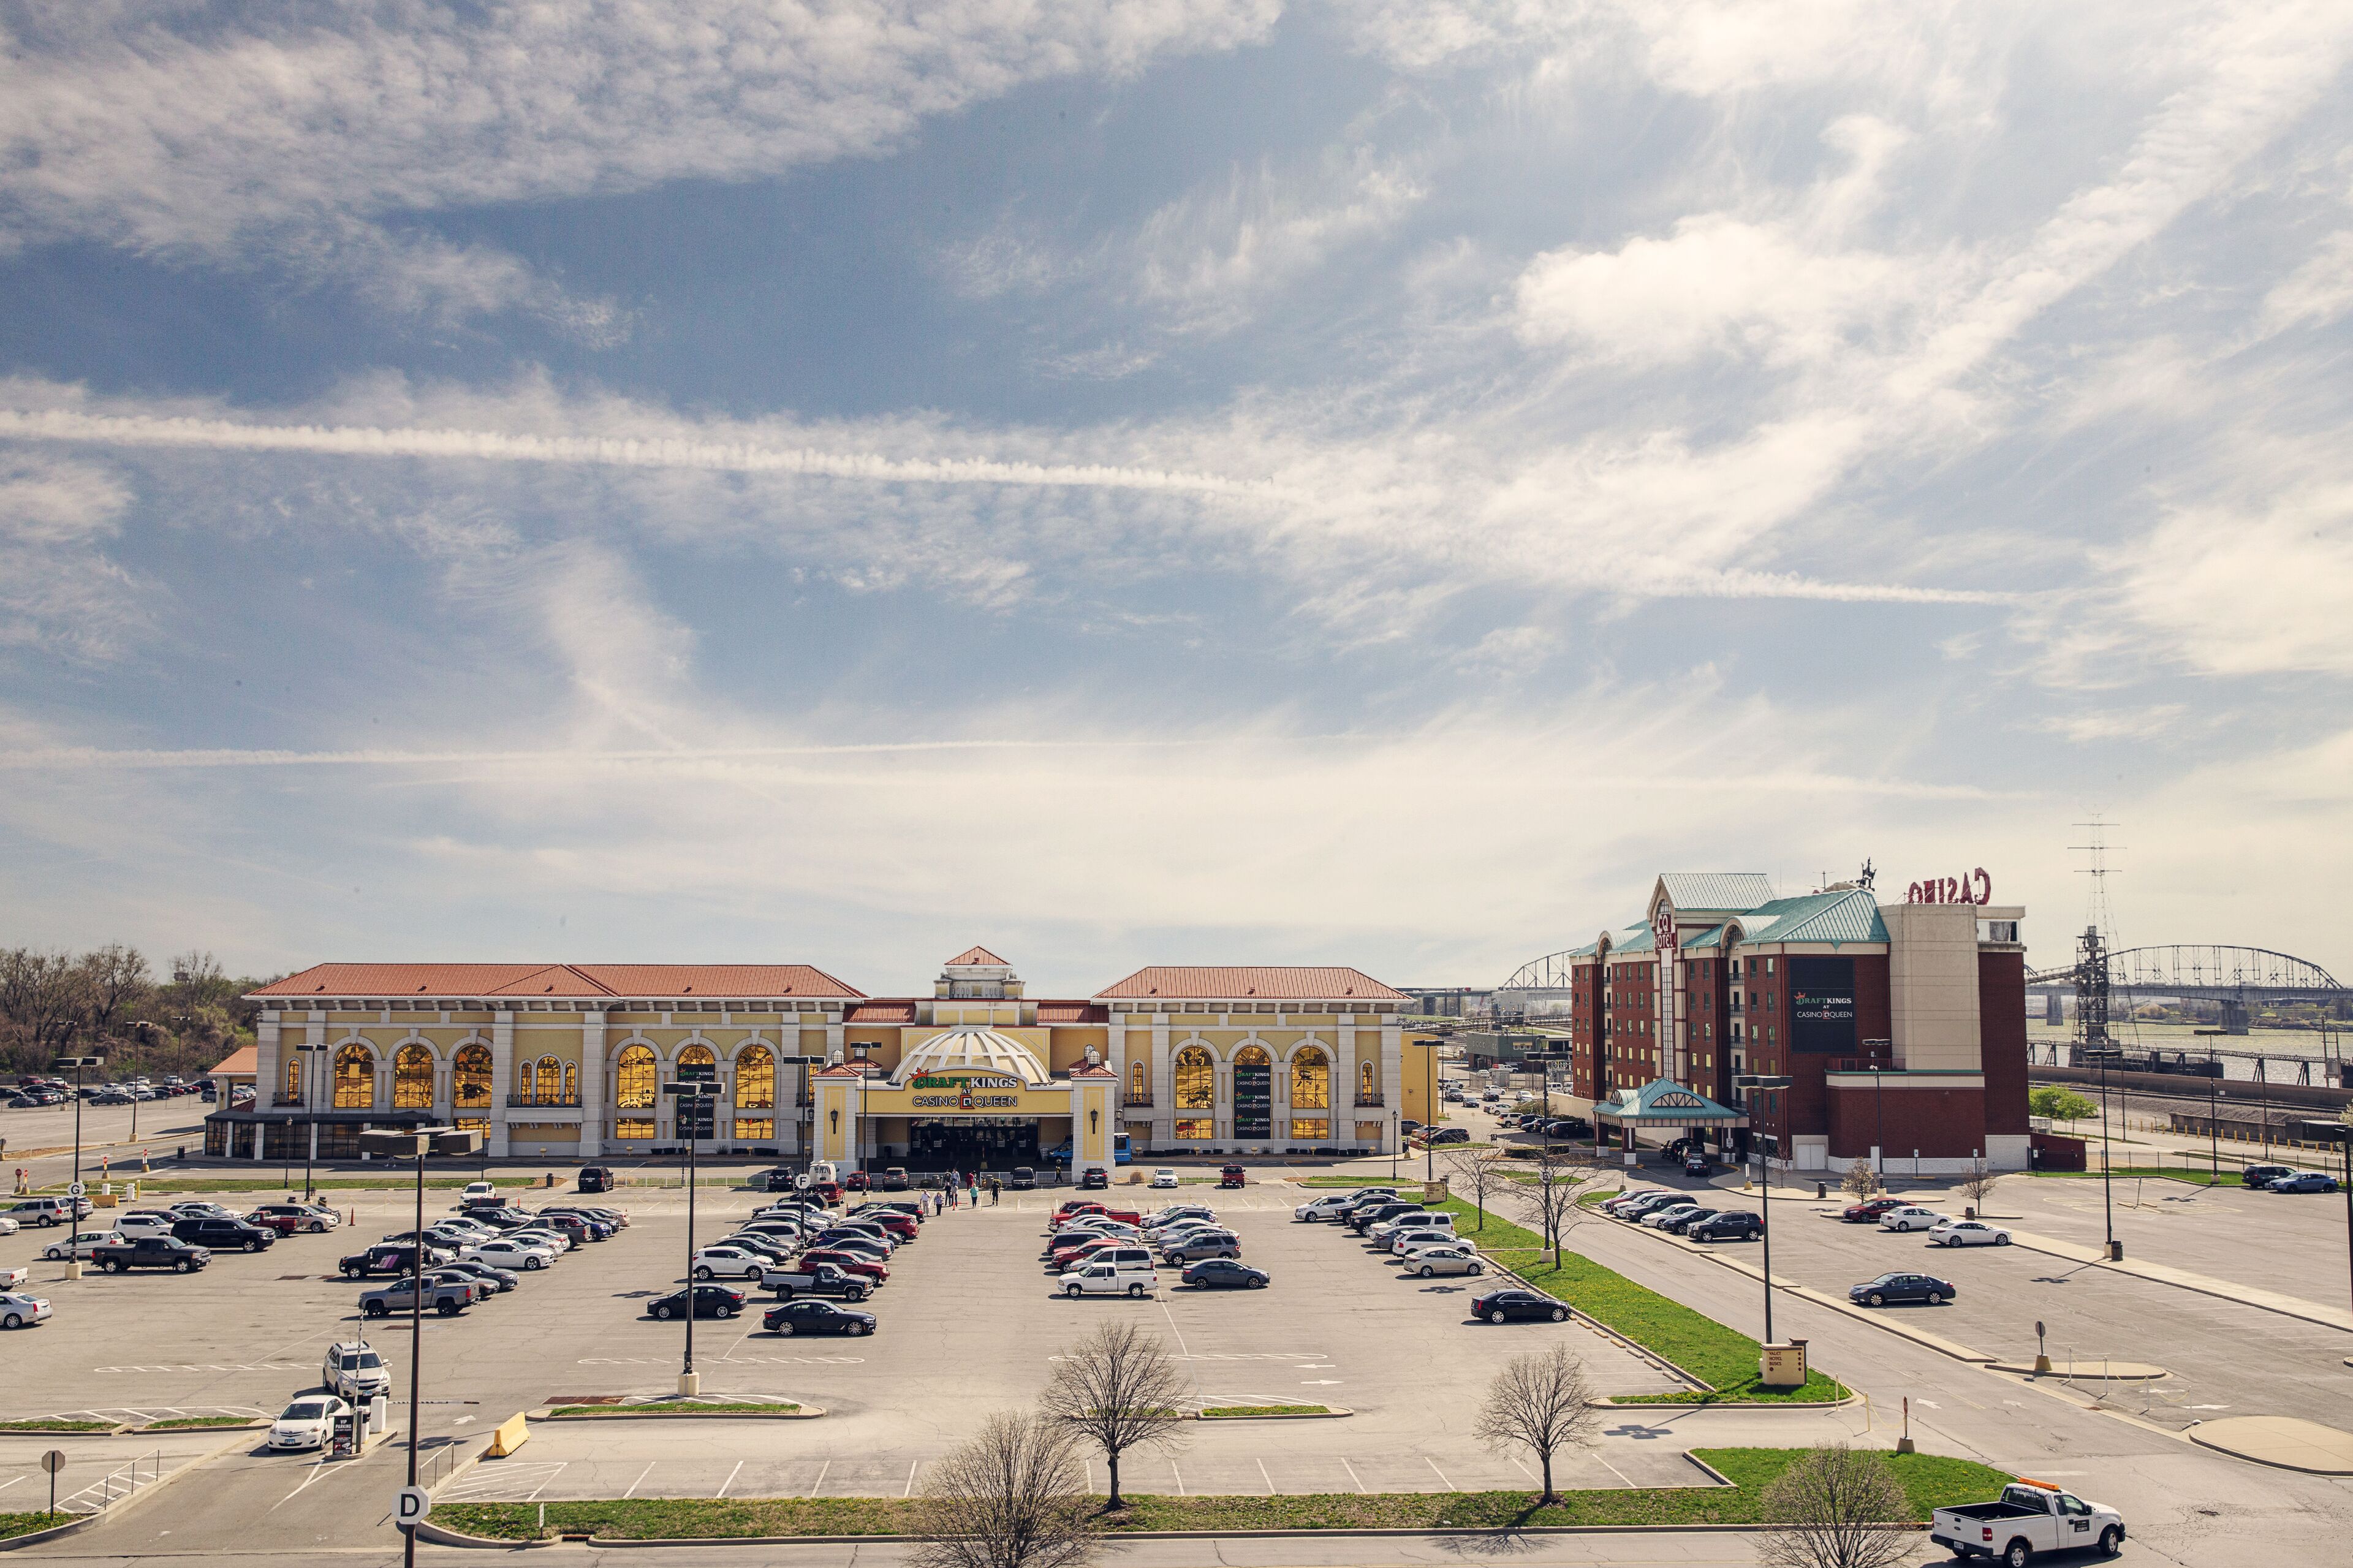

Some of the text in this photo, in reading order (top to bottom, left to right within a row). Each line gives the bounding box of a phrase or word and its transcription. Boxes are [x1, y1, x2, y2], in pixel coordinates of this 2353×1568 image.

[1657, 914, 1669, 932] CQ
[1654, 934, 1673, 948] HOTEL
[912, 1077, 1018, 1089] DRAFTKINGS
[912, 1096, 1018, 1108] CASINO QUEEN
[800, 1177, 806, 1186] F
[71, 1184, 80, 1194] G
[400, 1493, 420, 1517] D
